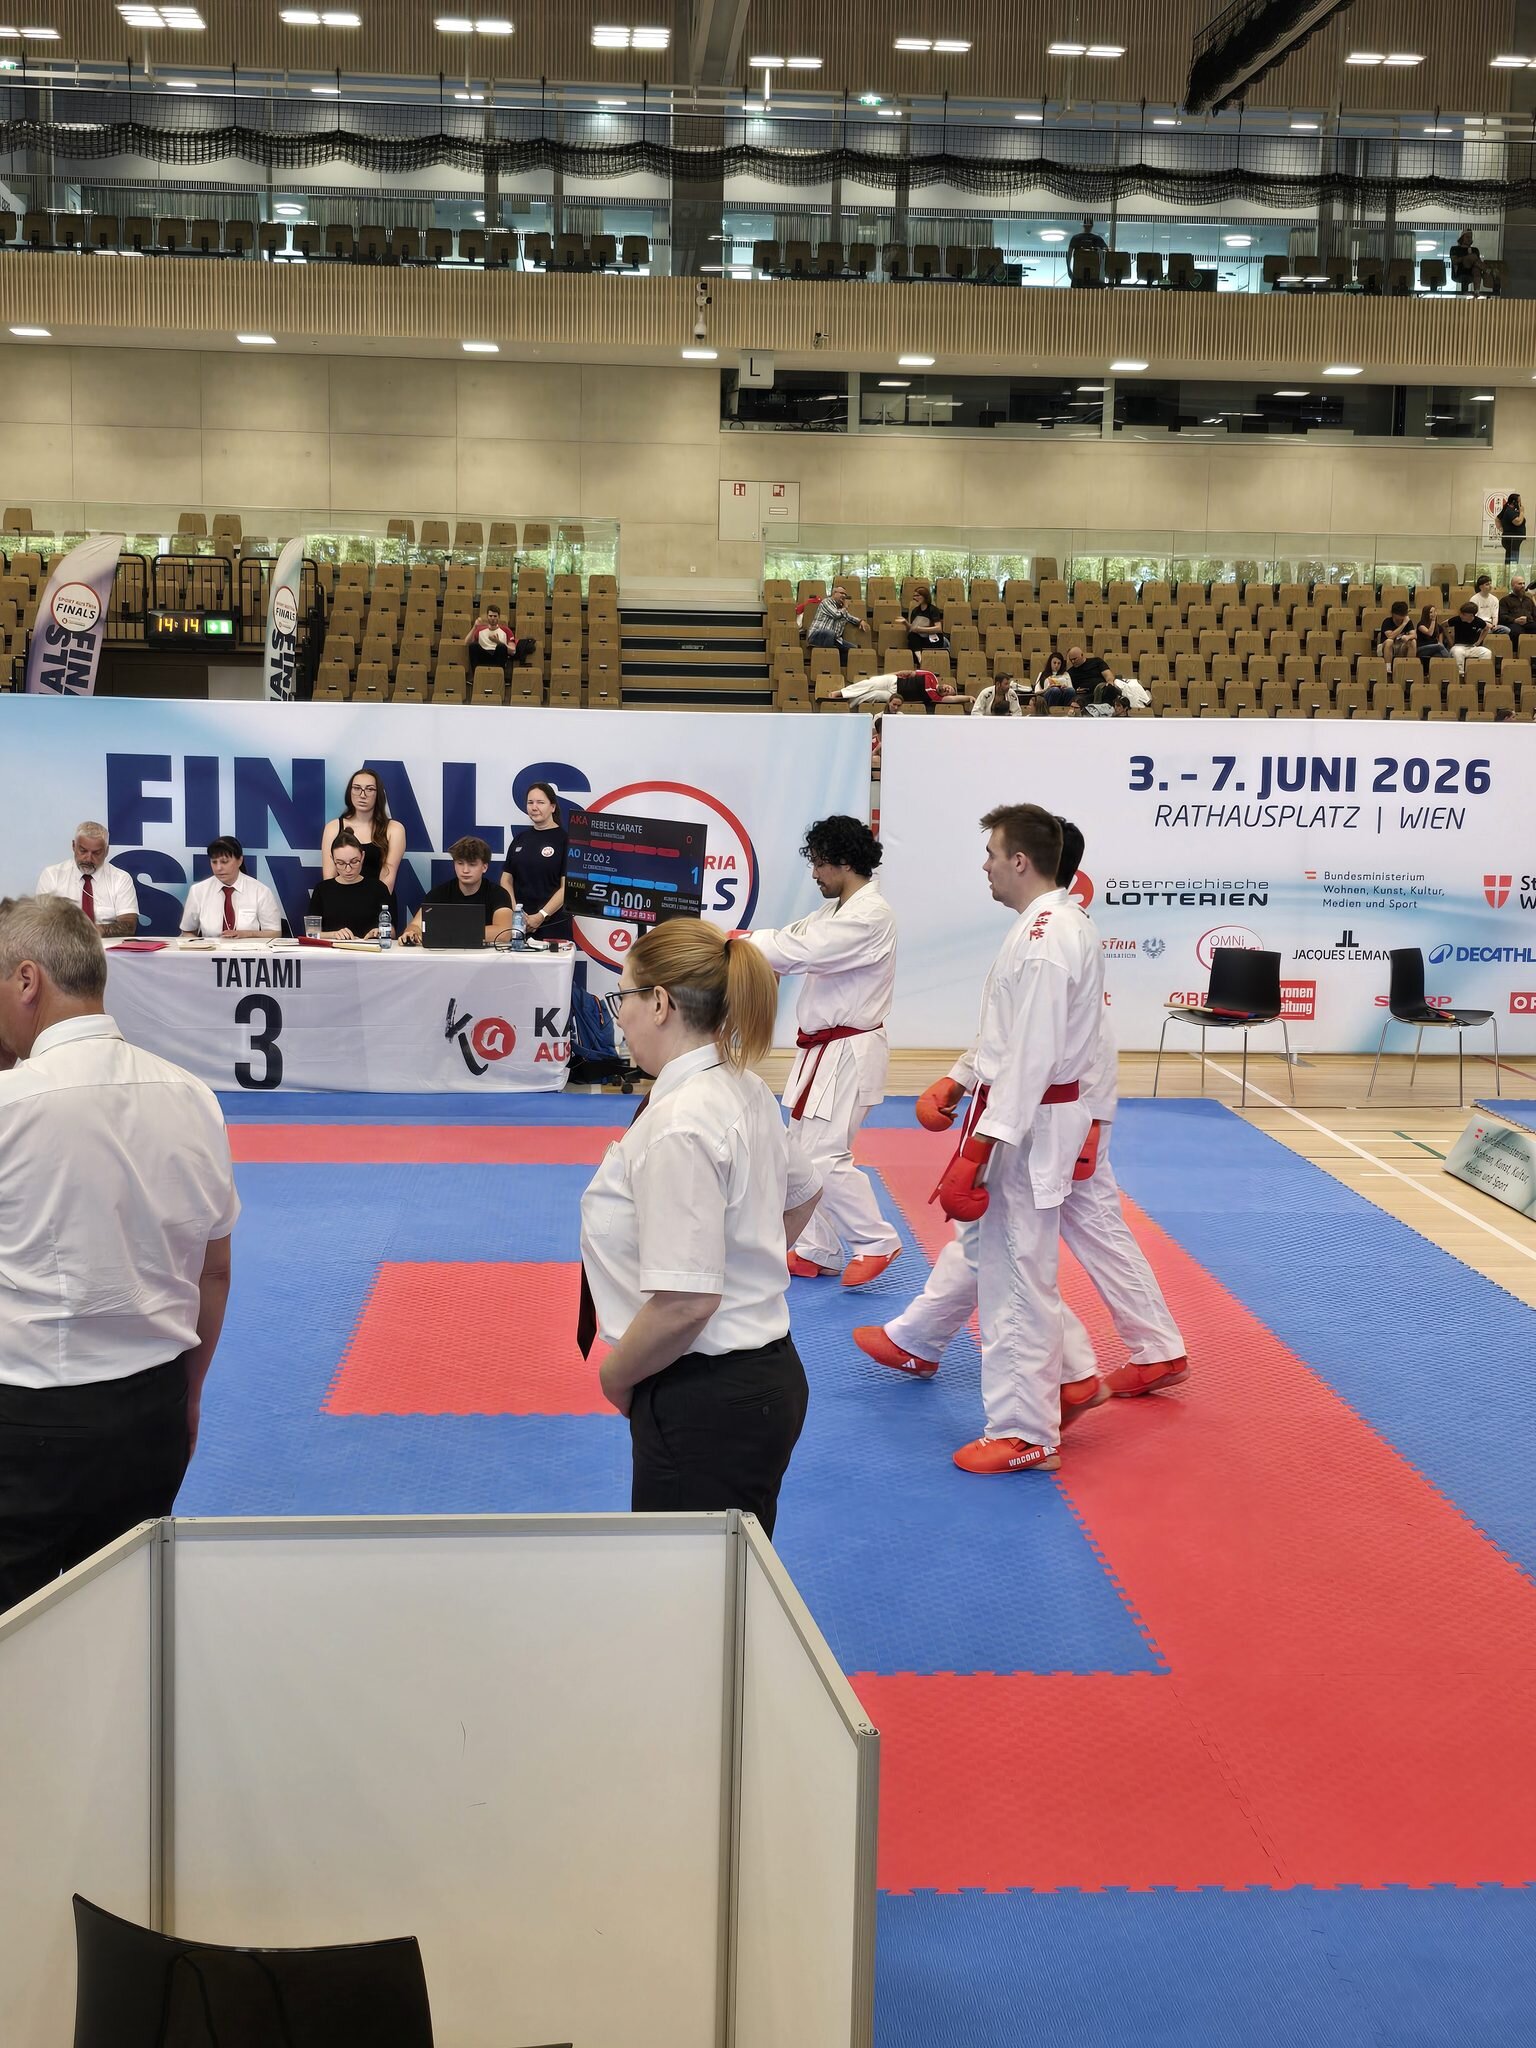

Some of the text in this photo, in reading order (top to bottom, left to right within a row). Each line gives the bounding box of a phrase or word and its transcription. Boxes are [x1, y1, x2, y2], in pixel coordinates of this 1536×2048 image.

[750, 357, 760, 376] L
[56, 603, 96, 619] FINALS
[275, 607, 295, 621] FINALS
[159, 618, 199, 632] 14:14
[1129, 755, 1168, 791] 3.
[1211, 756, 1246, 791] 7.
[1257, 756, 1357, 800] JUNI
[1372, 757, 1491, 794] 2026
[106, 753, 591, 854] FINALS
[570, 815, 643, 834] AKA REBELS KARATE
[1154, 804, 1360, 828] RATHAUSPLATZ
[1399, 806, 1466, 830] WIEN
[568, 848, 580, 858] AO
[583, 852, 592, 862] LZ
[605, 855, 611, 864] 2
[704, 855, 736, 870] RIA
[691, 866, 699, 885] 1
[1324, 871, 1425, 881] Bundesministerium
[1106, 878, 1269, 890] österreichische
[1323, 885, 1446, 897] Wohnen, Kunst, Kultur,
[1105, 892, 1268, 906] LOTTERIEN
[1323, 899, 1418, 910] Medien und Sport
[1101, 937, 1136, 950] STRIA
[1292, 949, 1392, 961] JACQUES LEMAN
[211, 957, 302, 988] TATAMI
[1280, 987, 1313, 998] ronen
[1280, 1000, 1313, 1015] eitung
[1374, 995, 1453, 1008] SRP
[234, 993, 283, 1090] 3
[1492, 1176, 1509, 1192] Sport
